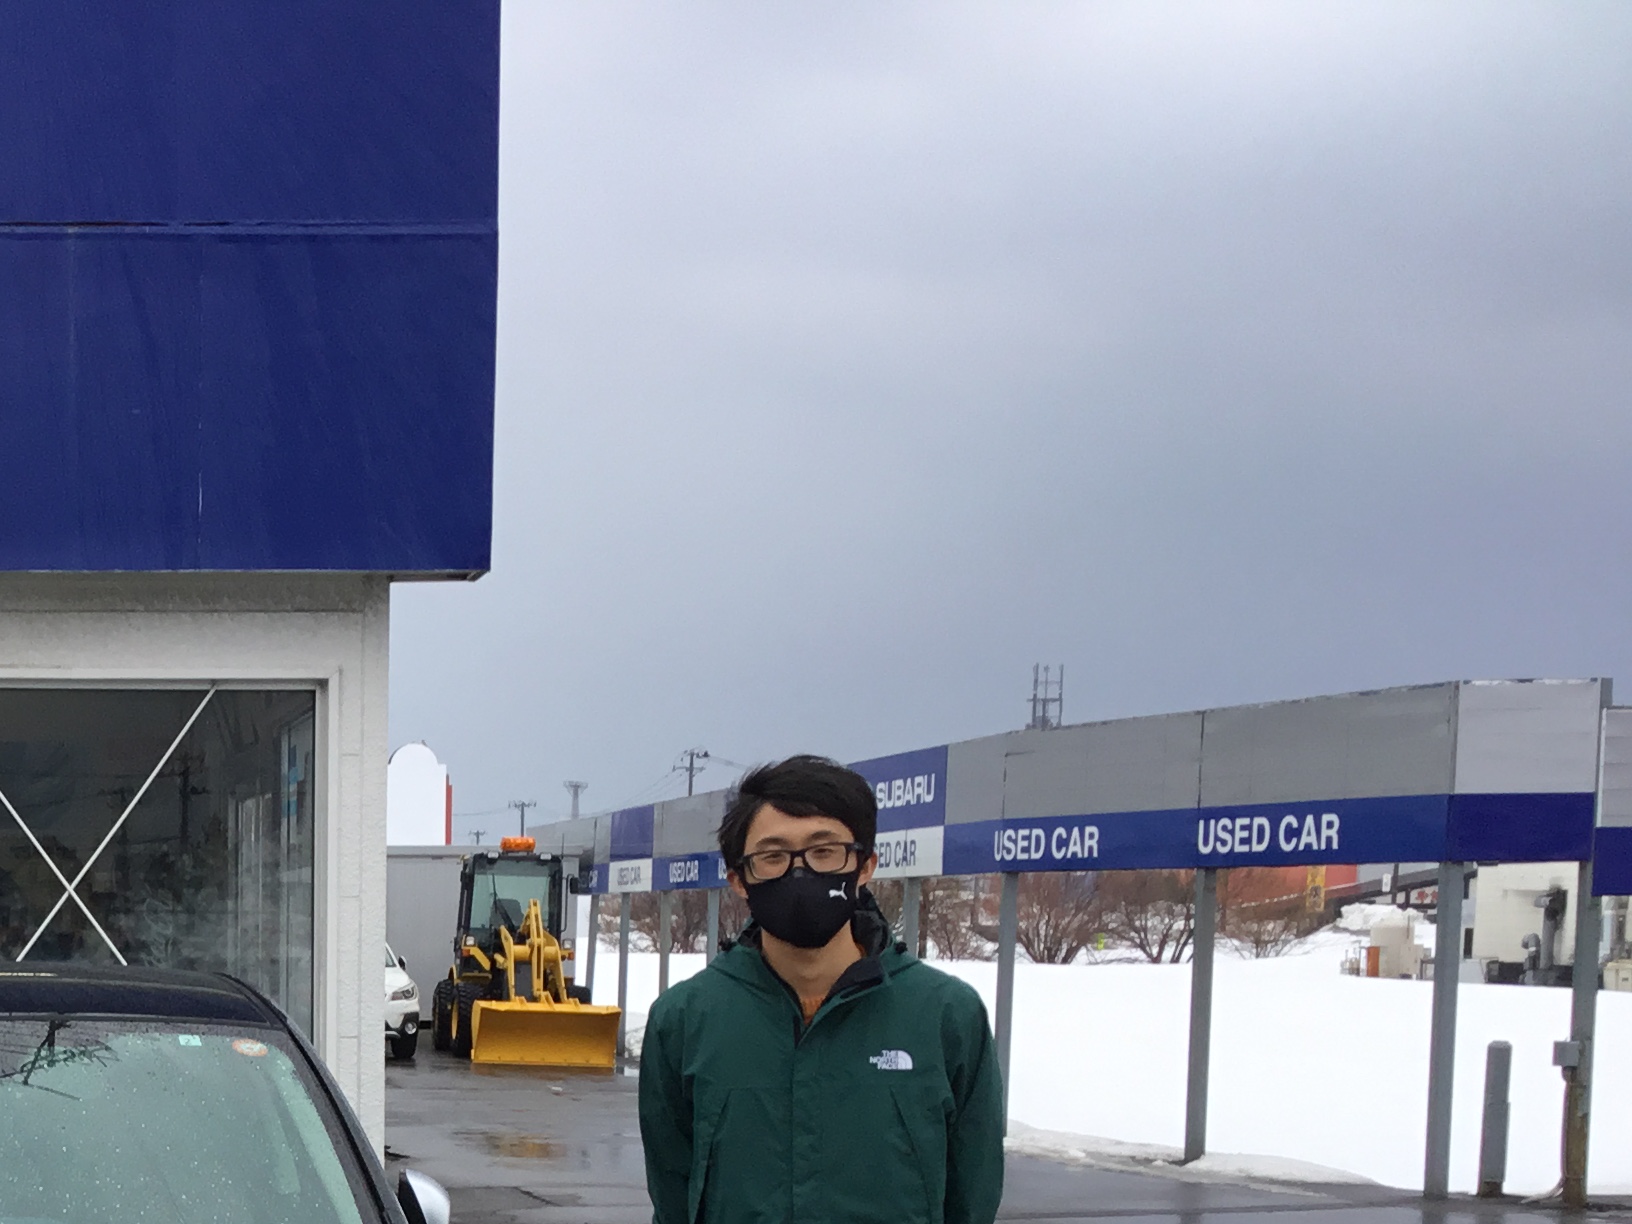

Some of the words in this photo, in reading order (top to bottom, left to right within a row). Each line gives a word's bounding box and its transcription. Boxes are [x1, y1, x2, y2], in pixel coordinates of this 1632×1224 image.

[875, 773, 936, 810] SUBARU
[994, 828, 1046, 862] USED
[1051, 825, 1100, 860] CAR
[1197, 815, 1270, 855] USED
[1279, 813, 1341, 851] CAR
[669, 860, 686, 883] USED
[686, 859, 699, 882] CAR
[894, 839, 917, 868] CAR
